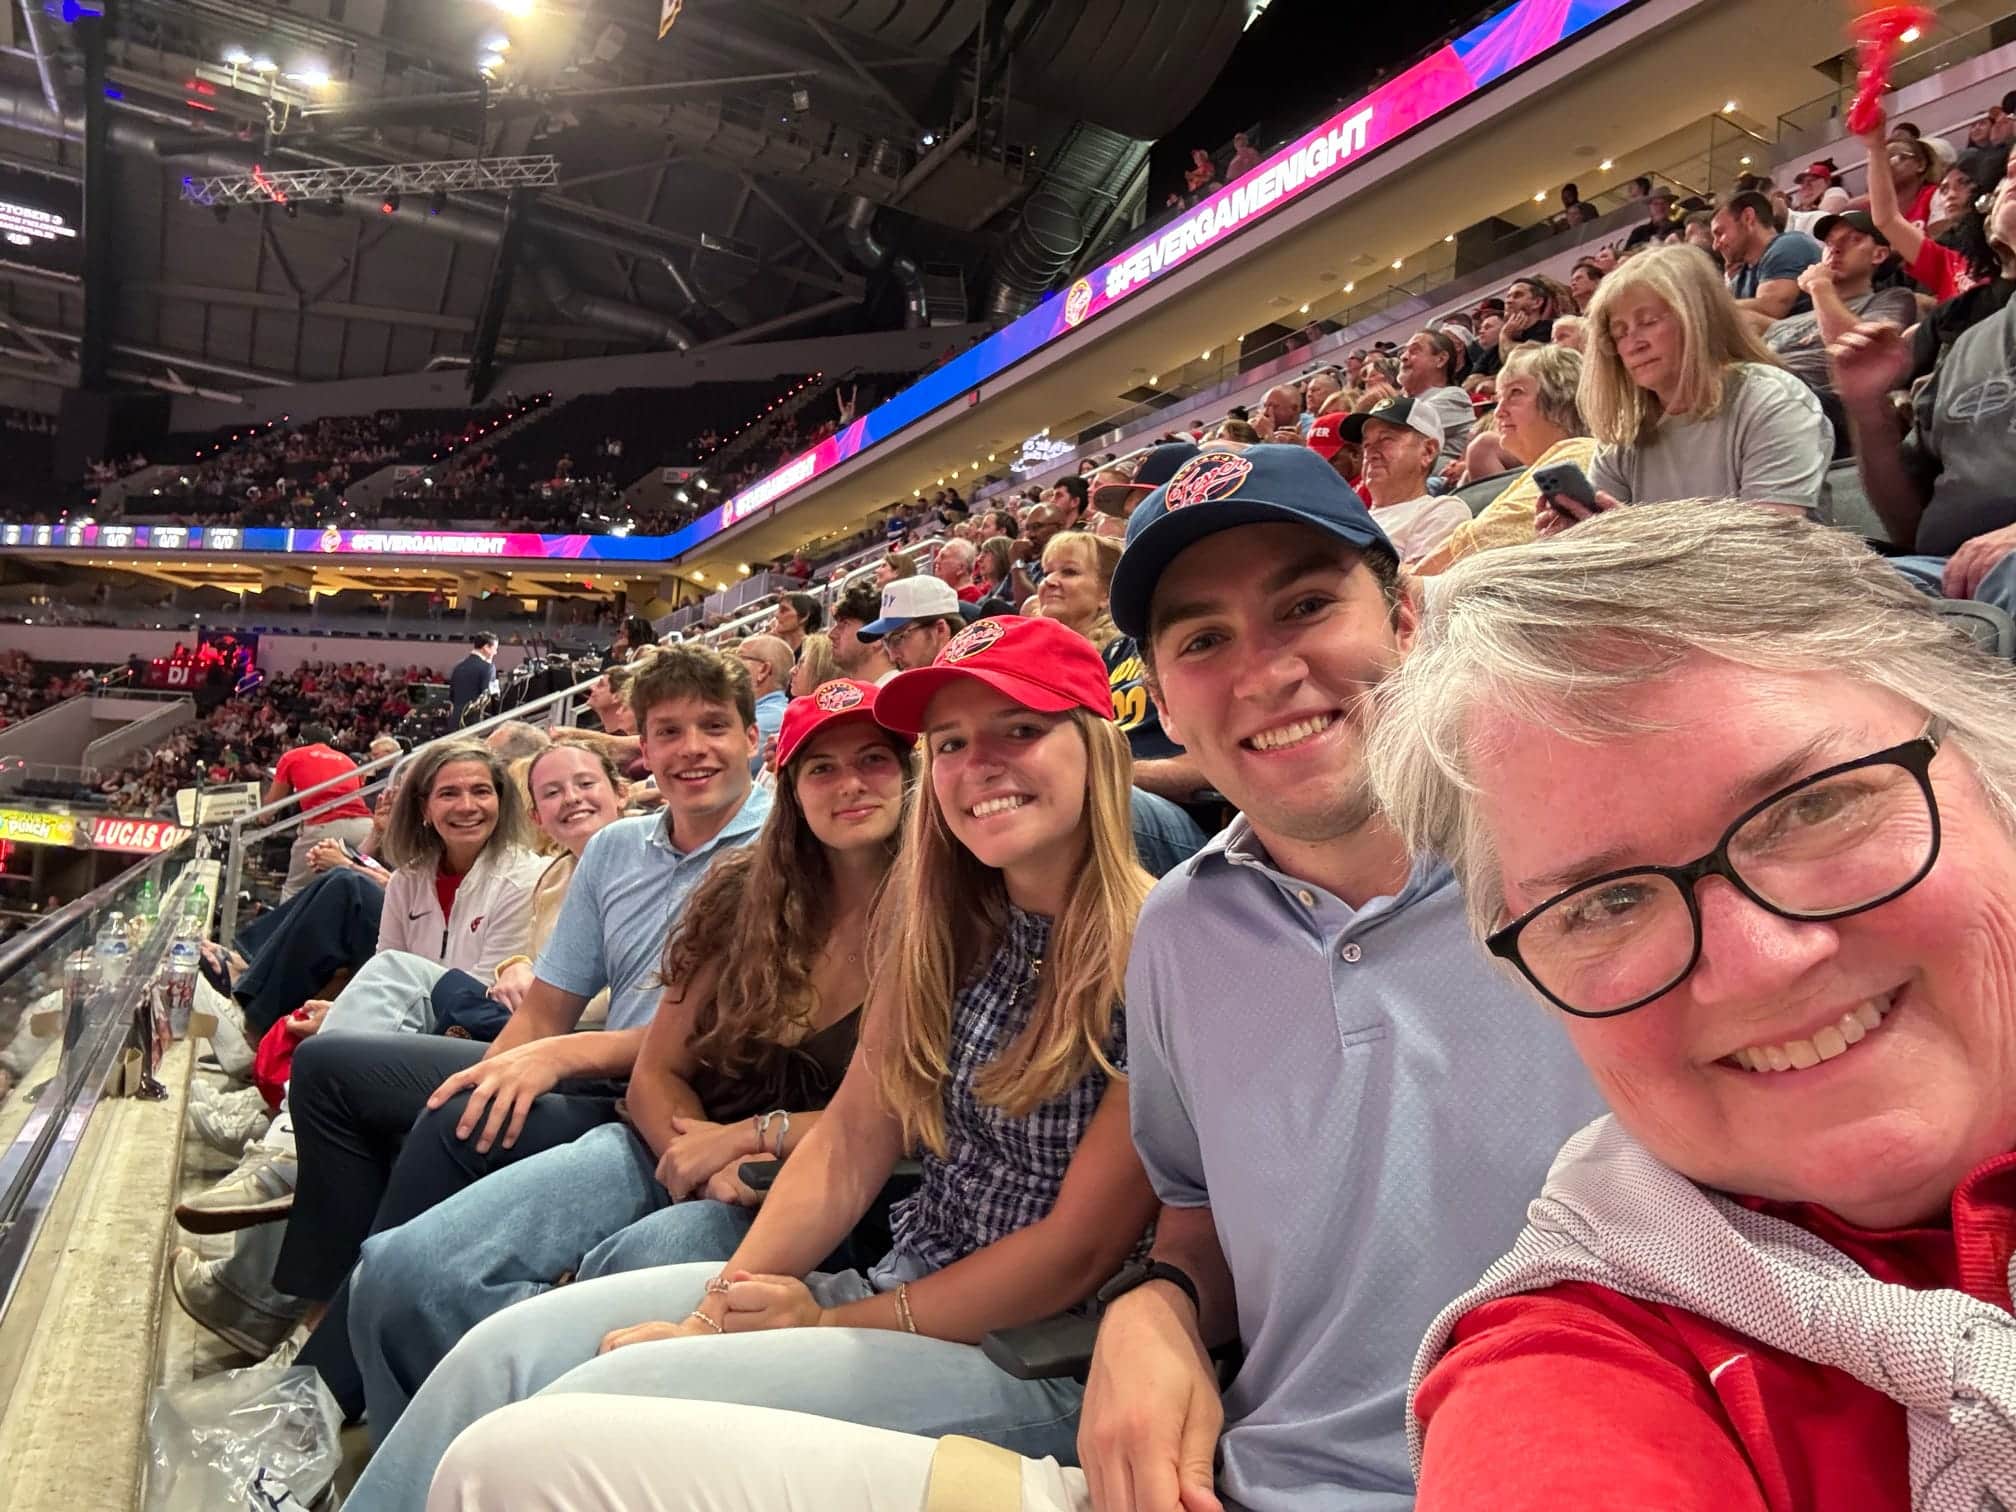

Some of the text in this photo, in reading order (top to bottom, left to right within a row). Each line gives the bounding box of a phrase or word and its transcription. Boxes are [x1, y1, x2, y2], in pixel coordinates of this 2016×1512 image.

[1105, 107, 1373, 299] #FEVERGAMENIGHT
[168, 666, 189, 685] DJ
[94, 820, 159, 848] LUCAS
